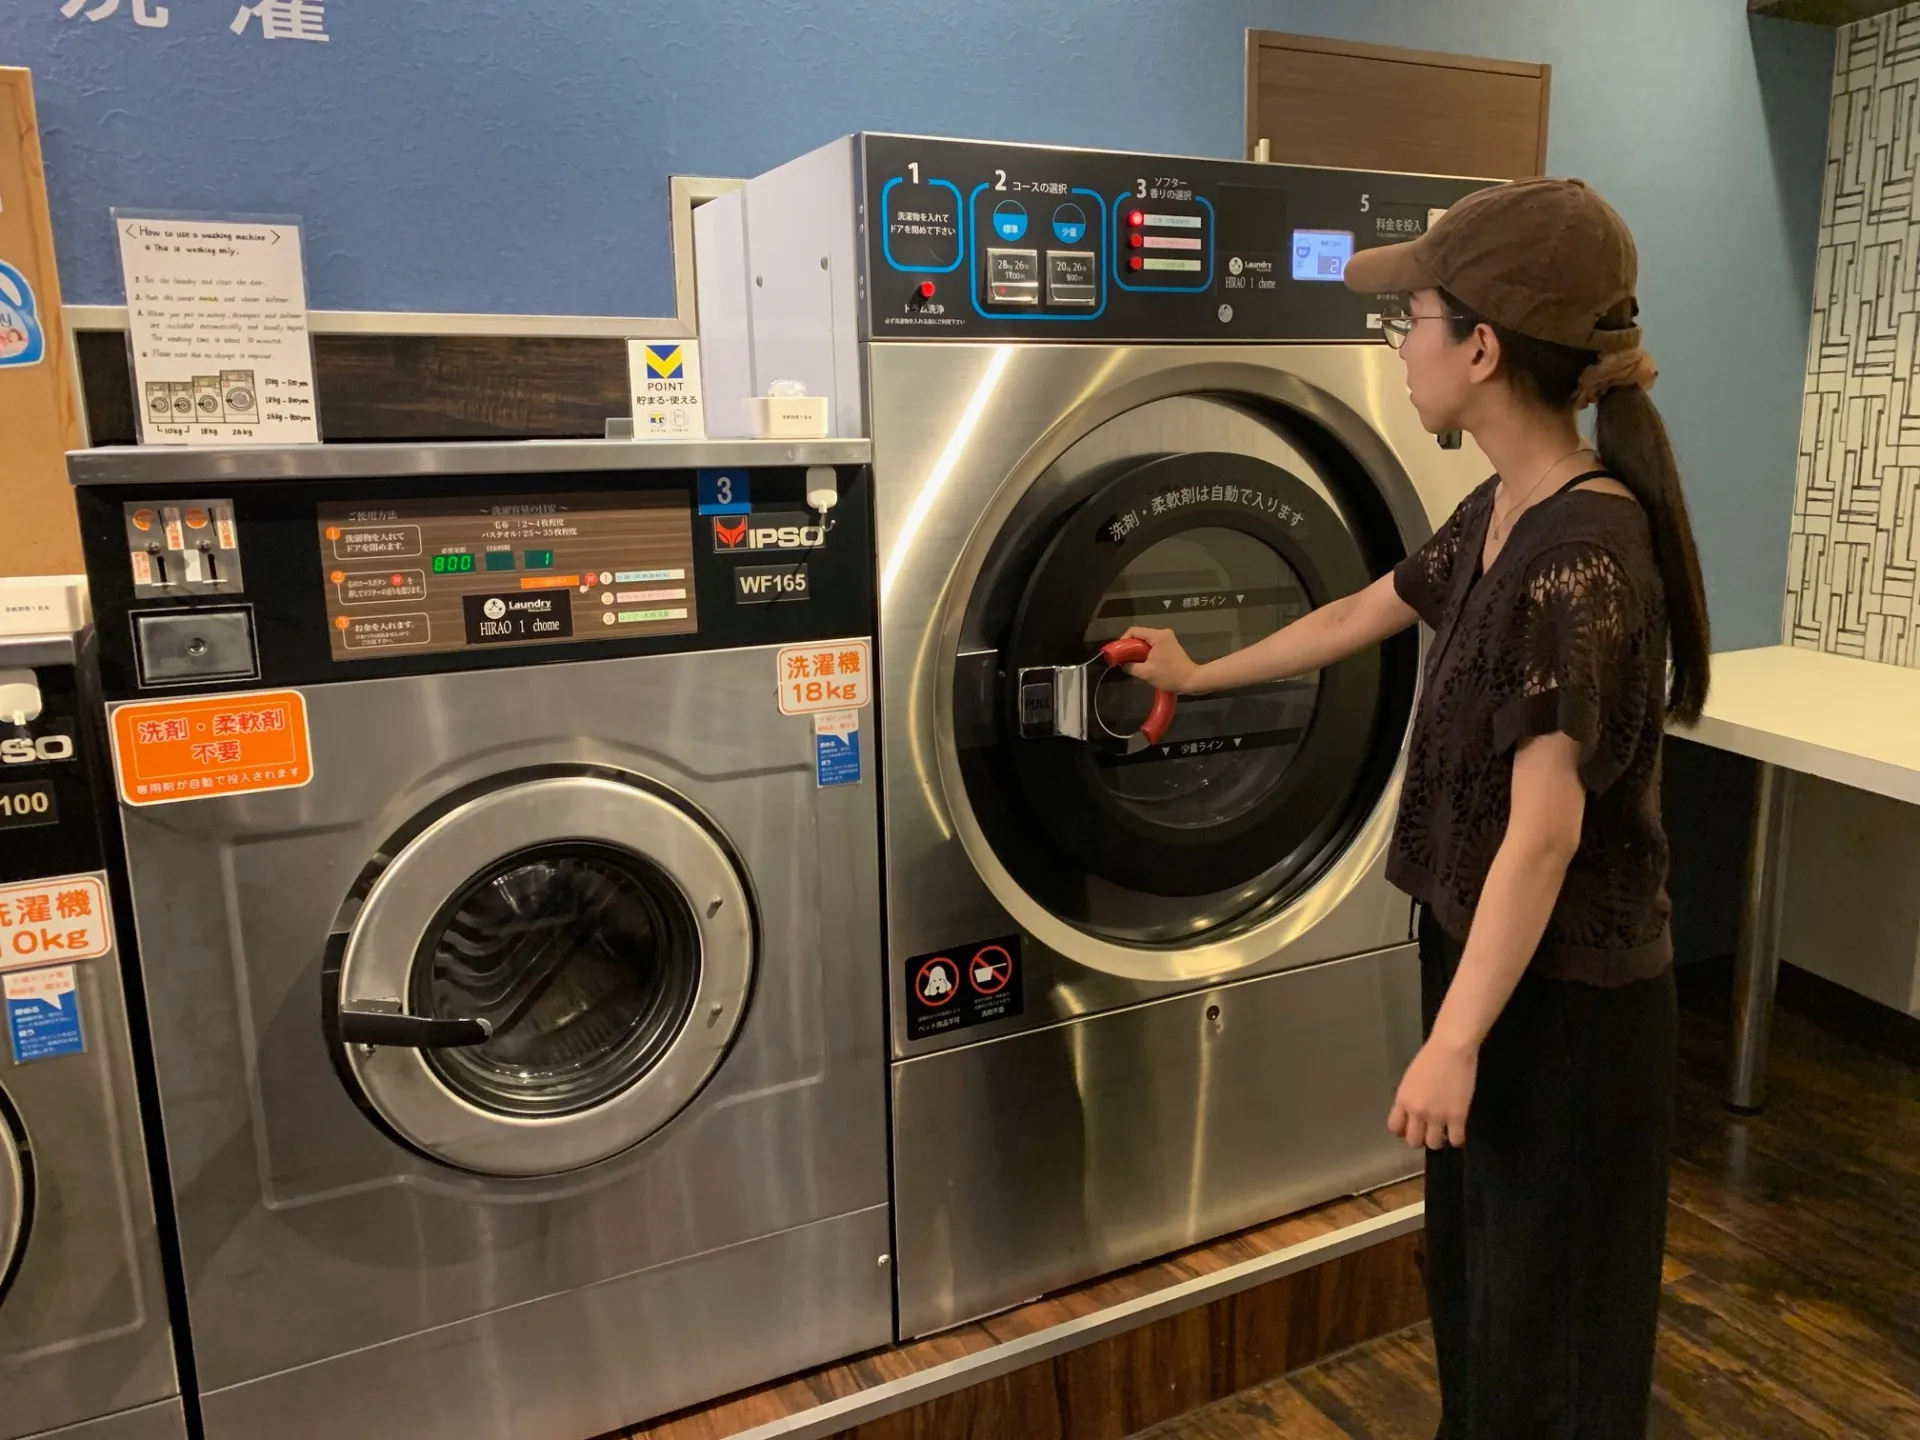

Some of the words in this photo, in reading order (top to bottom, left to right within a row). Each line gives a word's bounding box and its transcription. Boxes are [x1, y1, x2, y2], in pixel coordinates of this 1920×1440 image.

[907, 162, 920, 185] 1
[994, 169, 1008, 191] 2
[1013, 181, 1068, 195] コースの選択
[1135, 178, 1147, 199] 3
[1154, 177, 1188, 188] ソフター
[1150, 188, 1192, 201] 香りの選択
[1359, 194, 1370, 213] 5
[897, 211, 950, 224] 洗濯物を入れて
[139, 225, 161, 237] How
[201, 231, 232, 242] washing
[235, 232, 266, 242] machine
[890, 225, 956, 236] ドアを閉めて下さい
[646, 382, 685, 392] POINT
[636, 395, 698, 406] 貯まる・使える
[716, 476, 733, 505] 3
[348, 511, 399, 522] ご使用方法
[1109, 484, 1305, 542] 洗剤・柔軟剤は自動で入ります
[749, 526, 824, 550] IPSO
[433, 555, 471, 572] 800
[739, 574, 807, 595] WF165
[508, 598, 552, 610] Laundry
[1182, 595, 1226, 608] 標準ライン
[480, 620, 513, 636] HIRAO
[519, 620, 525, 633] 1
[532, 617, 560, 632] chome
[787, 650, 860, 680] 洗濯機
[792, 680, 857, 703] 18kg
[1025, 698, 1050, 711] PULL
[137, 708, 285, 744] 洗剤・柔軟剤
[191, 740, 241, 764] 不要
[1181, 740, 1224, 754] 少量ライン
[136, 767, 300, 796] 専用剤が自動で投入されます
[0, 928, 90, 959] 0kg
